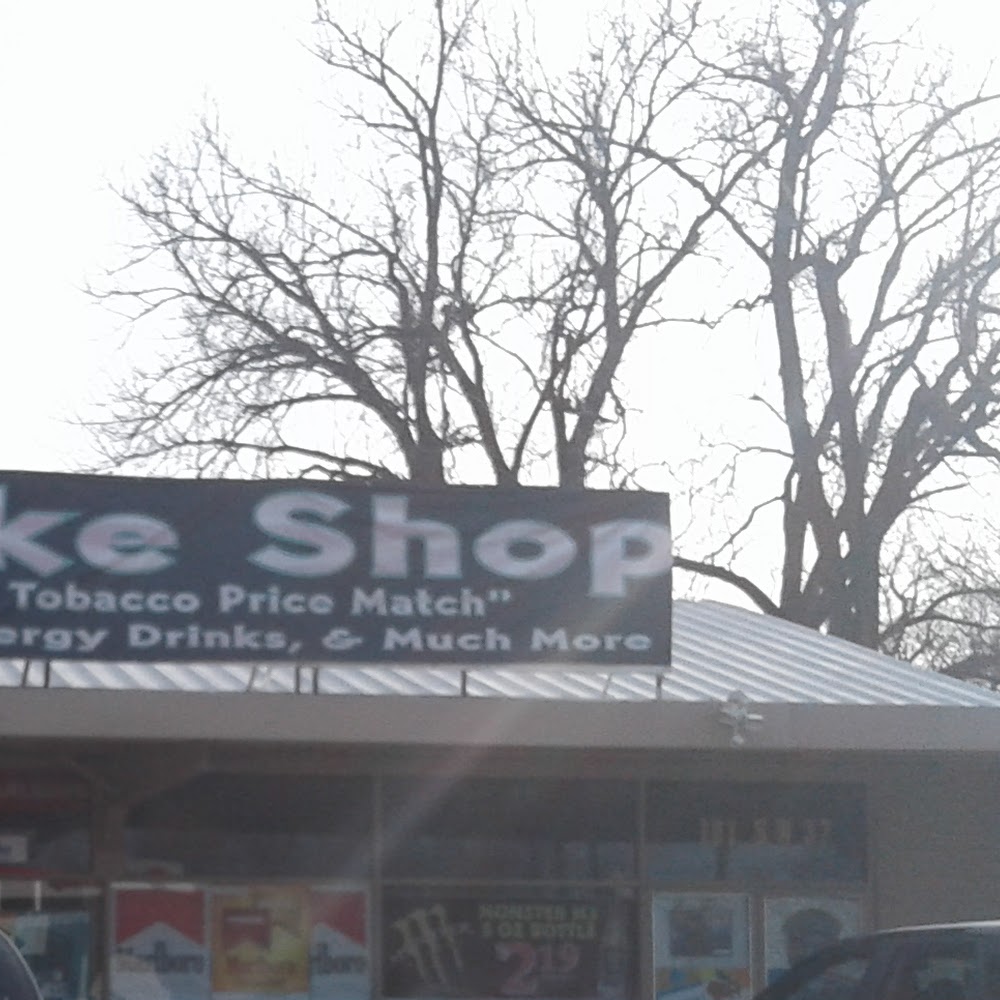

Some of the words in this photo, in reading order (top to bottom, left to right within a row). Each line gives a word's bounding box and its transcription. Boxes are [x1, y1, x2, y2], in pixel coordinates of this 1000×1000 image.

[247, 490, 671, 598] Shop
[9, 581, 199, 614] Tobacco
[219, 584, 334, 616] Price
[351, 586, 511, 617] Match"
[128, 623, 303, 655] Drinks,
[322, 629, 363, 650] &
[383, 628, 511, 653] Much
[531, 628, 653, 654] More
